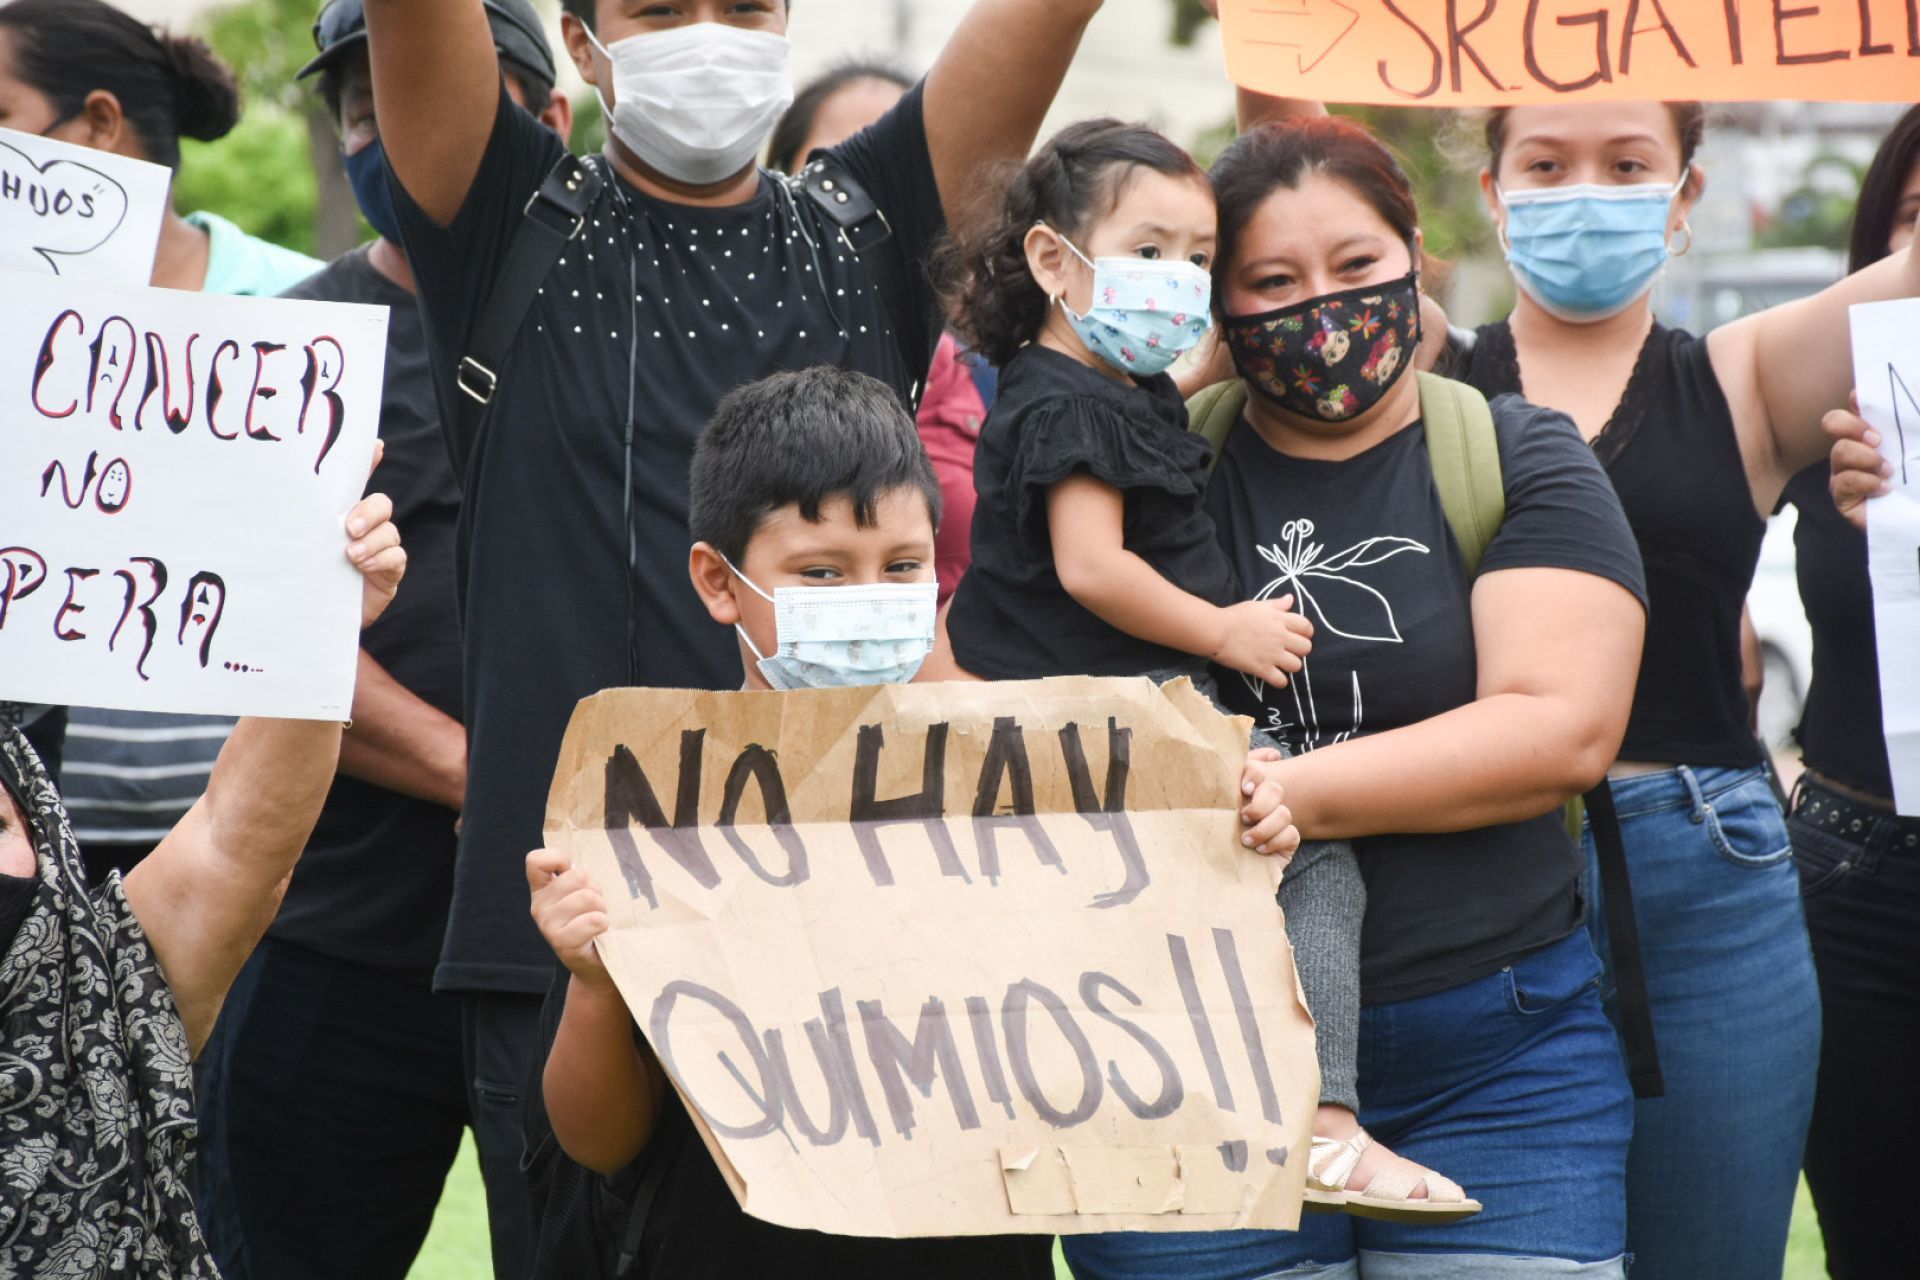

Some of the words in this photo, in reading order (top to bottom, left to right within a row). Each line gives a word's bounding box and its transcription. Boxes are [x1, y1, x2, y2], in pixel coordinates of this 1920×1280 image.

[31, 308, 346, 476] CANCER
[40, 450, 132, 515] NO
[603, 728, 810, 910] NO
[849, 716, 1151, 909] HAY
